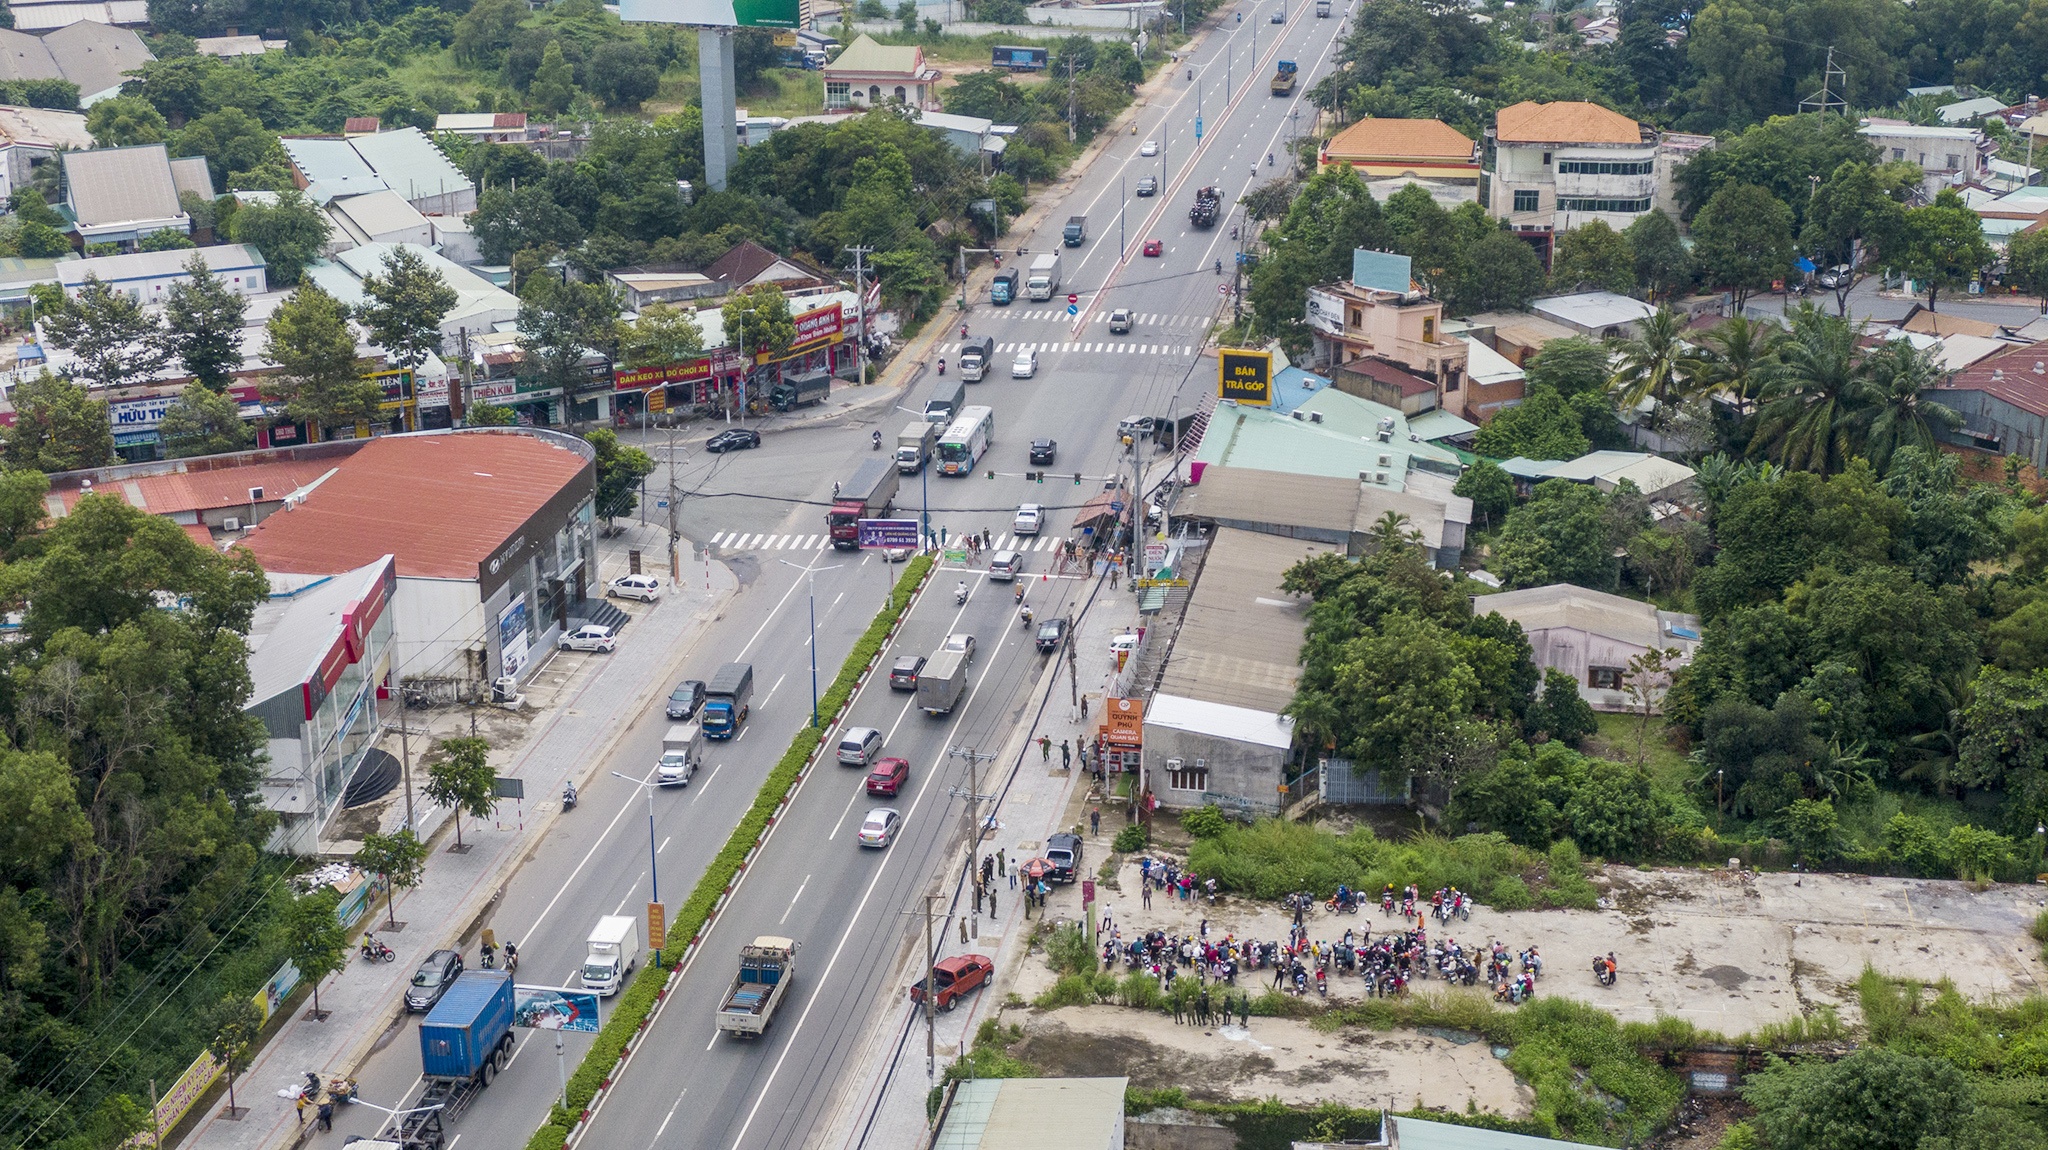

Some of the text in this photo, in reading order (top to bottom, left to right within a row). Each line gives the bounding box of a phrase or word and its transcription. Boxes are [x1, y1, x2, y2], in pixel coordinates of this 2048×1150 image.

[698, 365, 709, 373] XE
[1235, 365, 1256, 376] BÁN
[1225, 379, 1265, 391] TRẢ GÓP
[473, 386, 496, 398] THIÊN
[497, 385, 513, 395] KIM
[118, 408, 167, 423] HỮU TH
